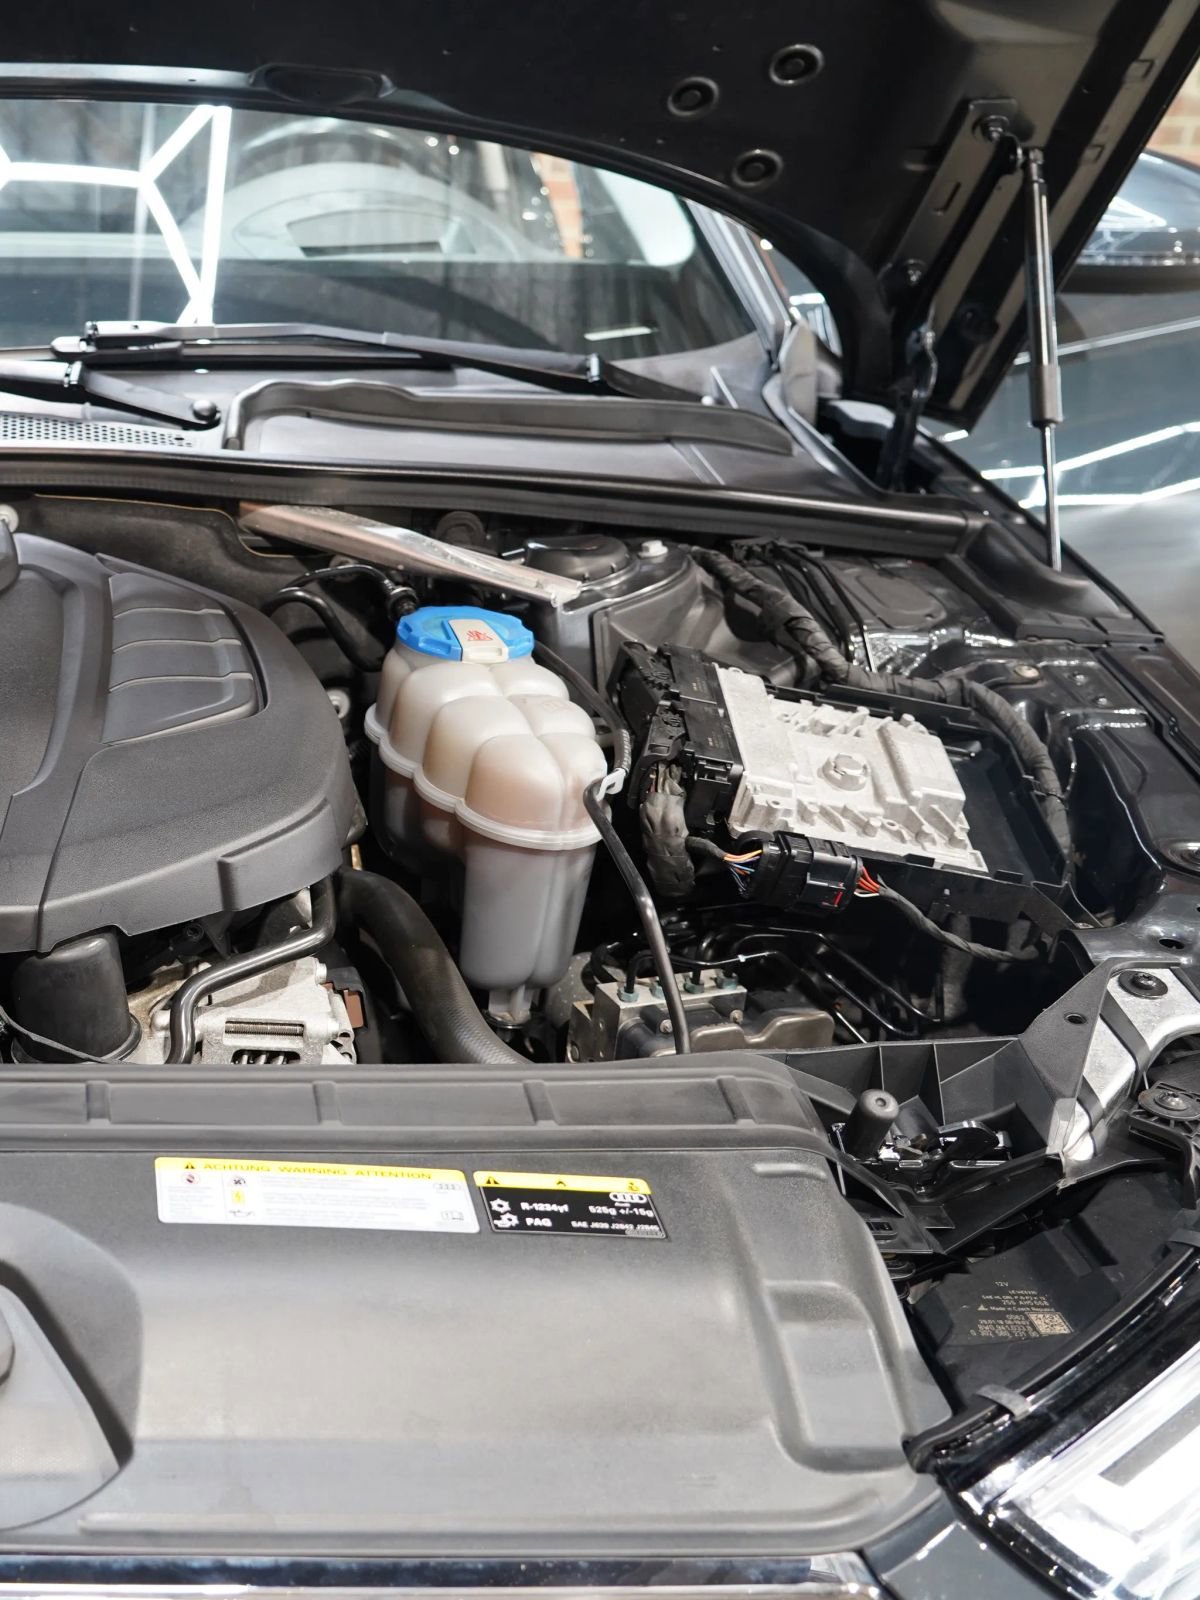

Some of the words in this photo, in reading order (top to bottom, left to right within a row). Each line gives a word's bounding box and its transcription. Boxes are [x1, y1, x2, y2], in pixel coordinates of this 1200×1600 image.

[203, 1163, 271, 1172] ACHTUNG
[278, 1166, 347, 1176] WARNING
[355, 1169, 432, 1180] ATTENTION
[520, 1202, 569, 1213] R-1234yf
[525, 1217, 552, 1227] PAG
